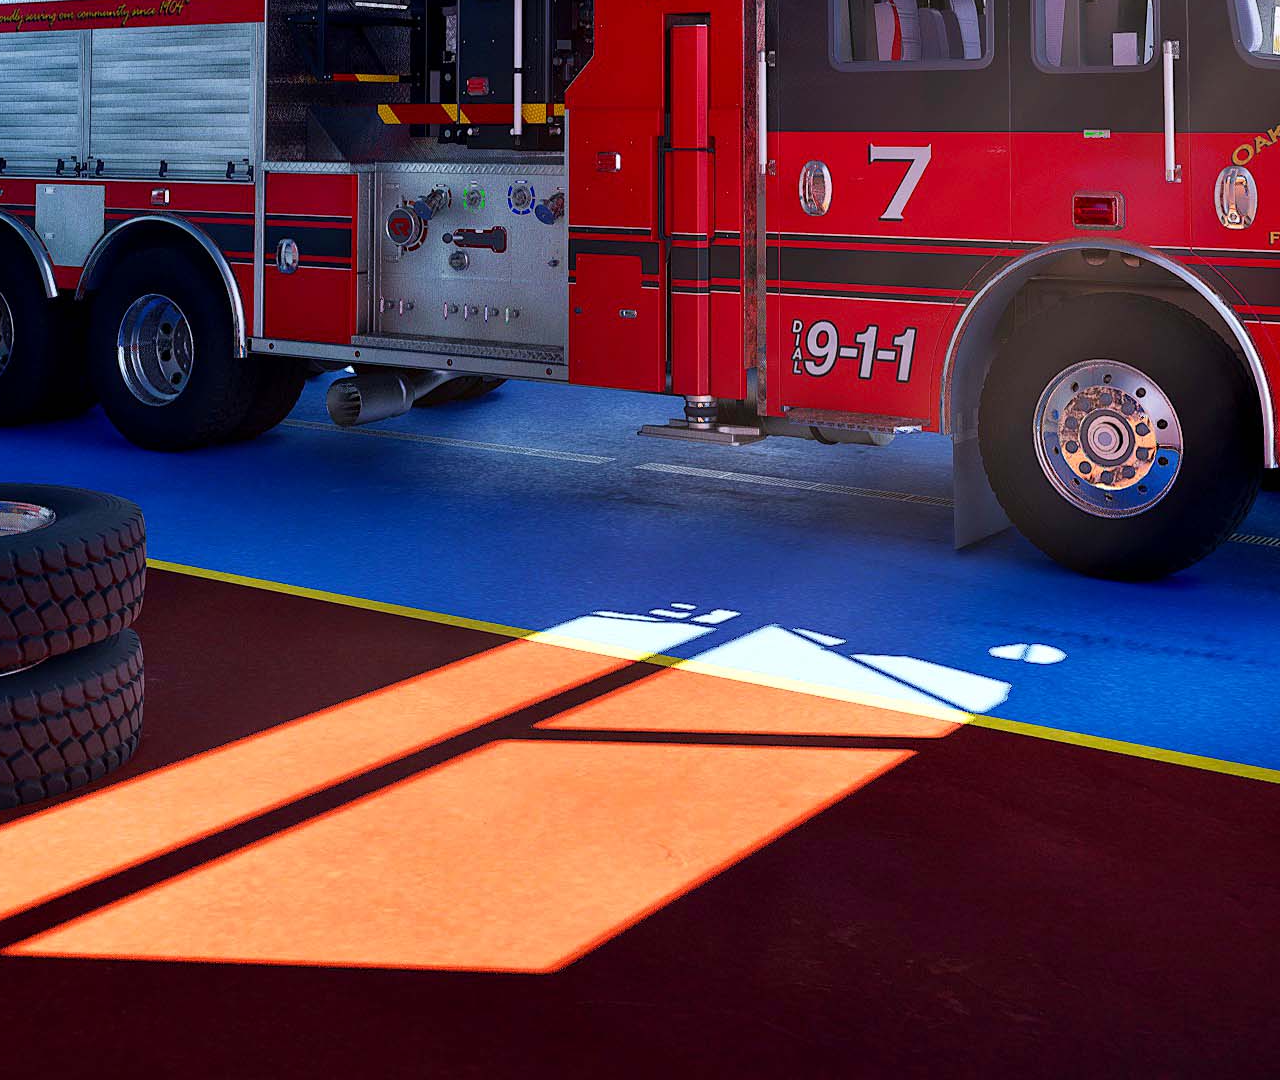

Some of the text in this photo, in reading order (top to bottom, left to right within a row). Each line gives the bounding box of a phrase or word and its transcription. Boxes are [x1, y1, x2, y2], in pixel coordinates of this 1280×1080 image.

[77, 4, 129, 26] community
[131, 5, 156, 18] since
[868, 142, 932, 221] 7
[792, 319, 803, 375] DIAL
[804, 319, 917, 382] 9-1-1
